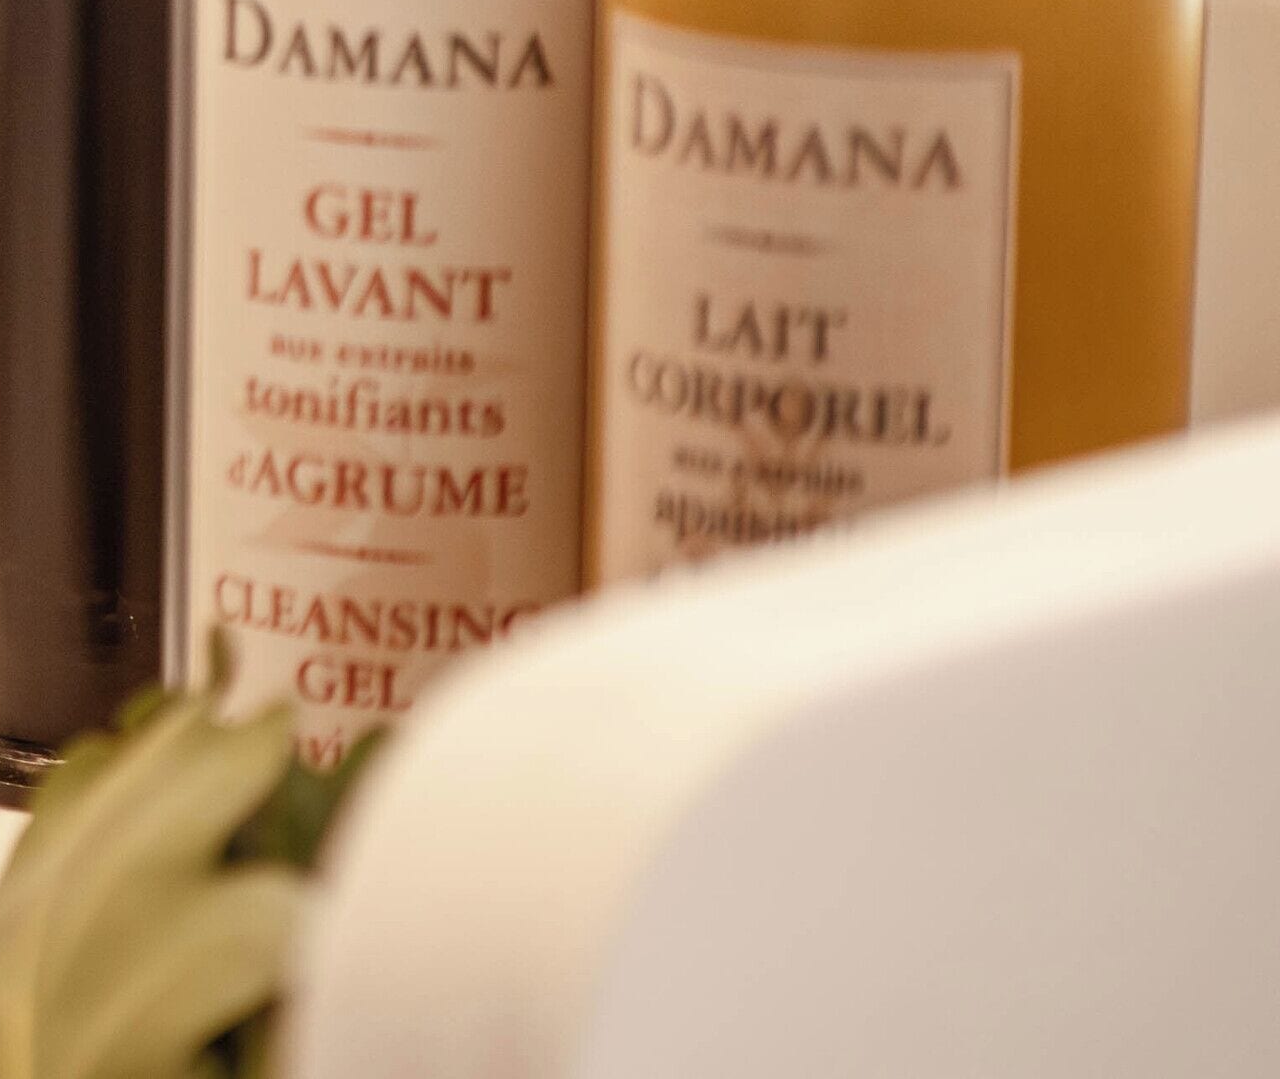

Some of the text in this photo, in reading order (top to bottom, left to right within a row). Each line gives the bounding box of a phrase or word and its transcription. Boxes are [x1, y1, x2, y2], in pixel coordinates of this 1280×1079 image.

[631, 74, 964, 193] DAMANA
[303, 183, 438, 246] GEL
[246, 248, 511, 322] LAVANT
[694, 290, 848, 363] LAIT
[246, 374, 506, 440] tonifiants
[627, 352, 953, 447] CORPOREL
[296, 654, 412, 712] GEL
